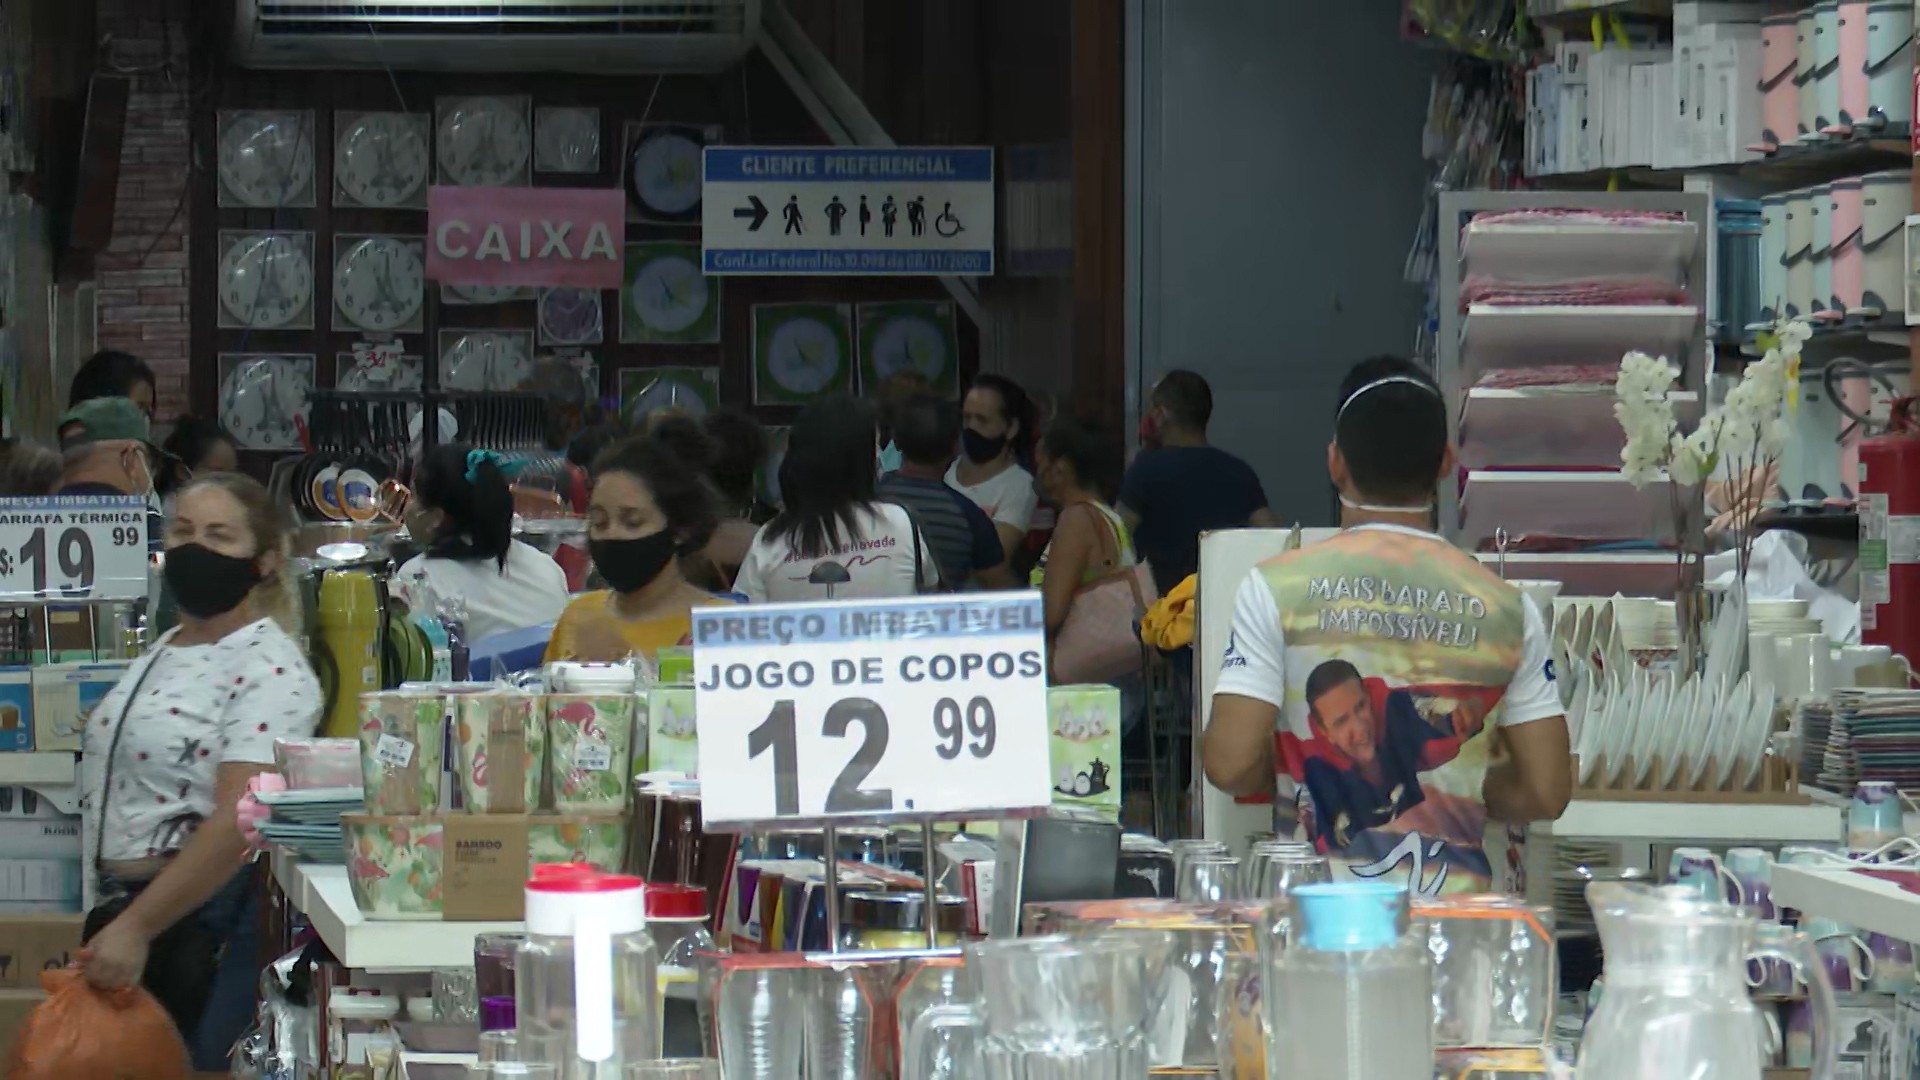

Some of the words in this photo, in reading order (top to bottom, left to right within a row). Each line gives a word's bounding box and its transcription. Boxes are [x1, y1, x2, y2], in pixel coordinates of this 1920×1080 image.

[741, 155, 816, 175] CLIENTE
[824, 155, 956, 175] PREFERENCIAL
[436, 218, 617, 263] CAIXA
[68, 511, 142, 524] TÉRMICA
[112, 526, 139, 546] 99
[1308, 576, 1374, 602] MAIS
[697, 613, 825, 646] PREÇO
[839, 604, 1043, 638] IMBATÍVEL
[699, 660, 815, 691] JOGO
[831, 657, 884, 685] DE
[899, 650, 1043, 683] COPOS
[932, 695, 997, 761] 99
